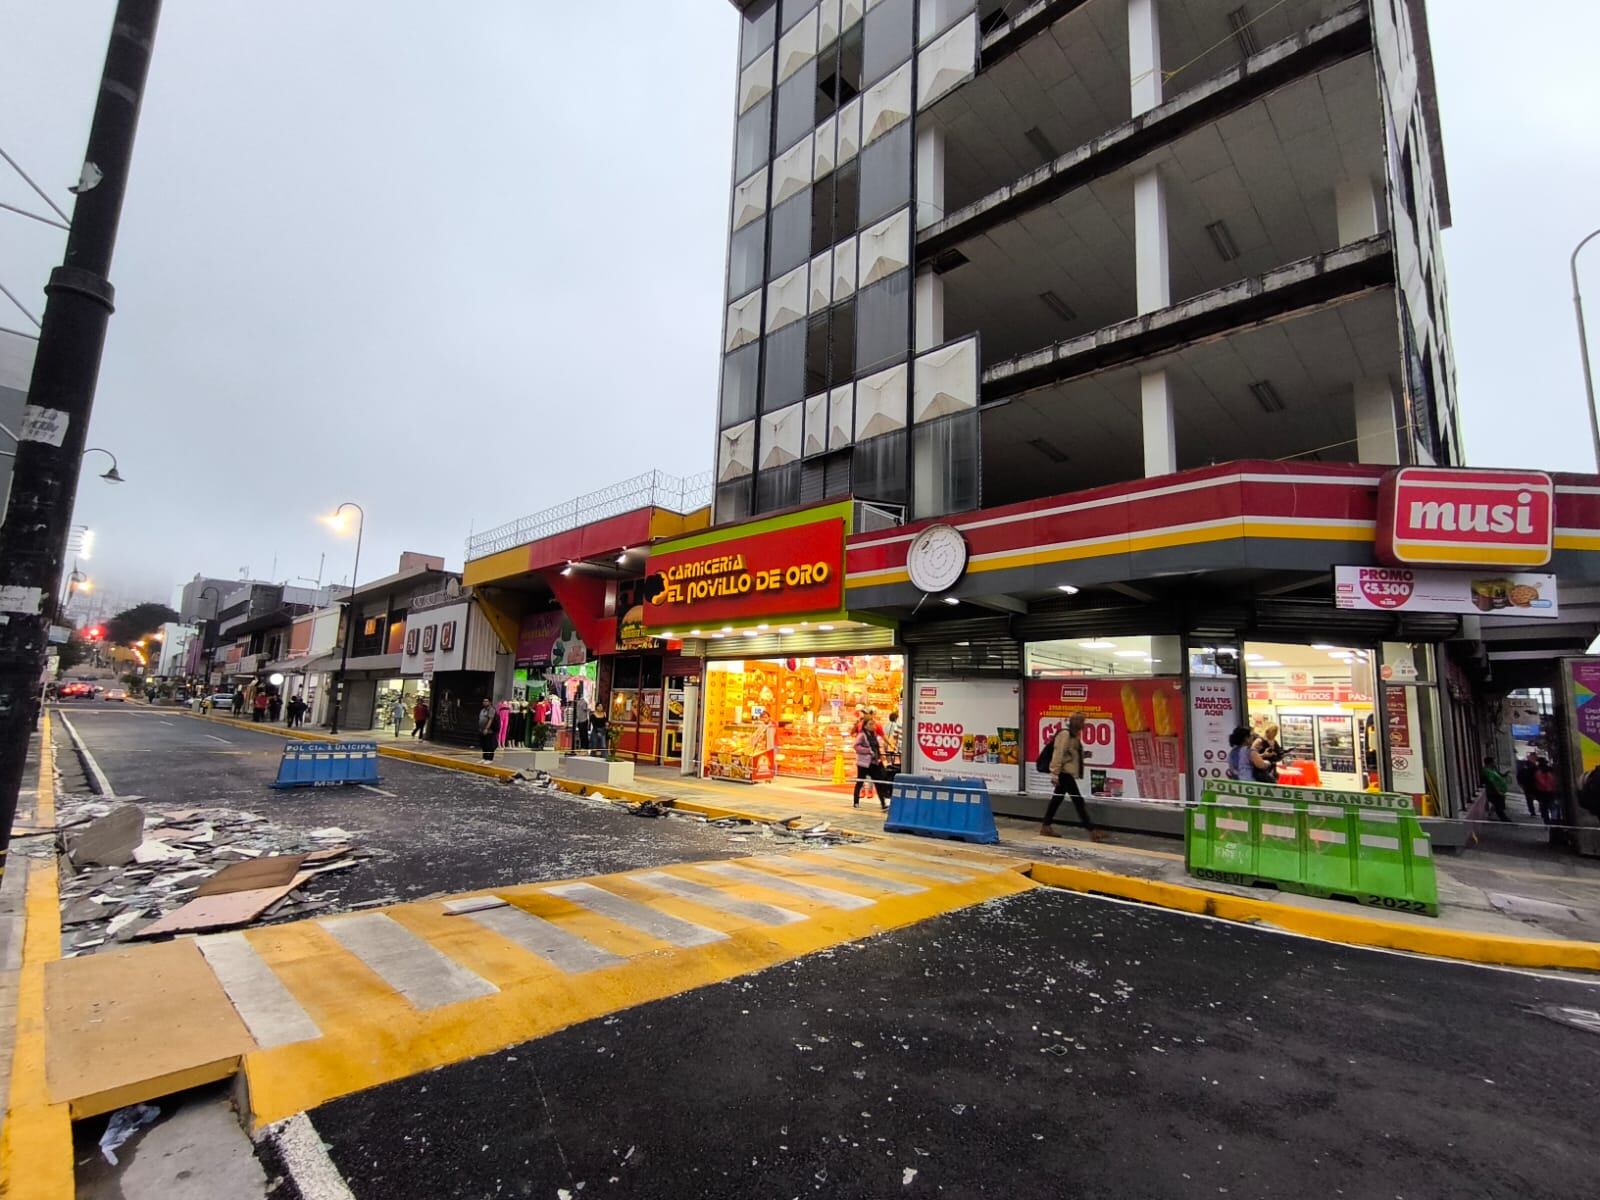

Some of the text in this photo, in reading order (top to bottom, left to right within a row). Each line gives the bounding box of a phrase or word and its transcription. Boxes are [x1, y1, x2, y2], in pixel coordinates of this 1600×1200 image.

[1409, 491, 1533, 534] musi
[667, 584, 683, 603] EL
[756, 568, 781, 591] DE
[785, 561, 829, 586] ORO
[1359, 568, 1414, 581] PROMO
[1194, 703, 1233, 711] SERVICIOS
[918, 722, 964, 735] PROMO
[286, 743, 376, 752] POLCI UNICIPA
[1206, 780, 1410, 810] POLICIA DE TRANSITO
[1196, 868, 1245, 884] COSEVI
[1368, 894, 1427, 912] 2022
